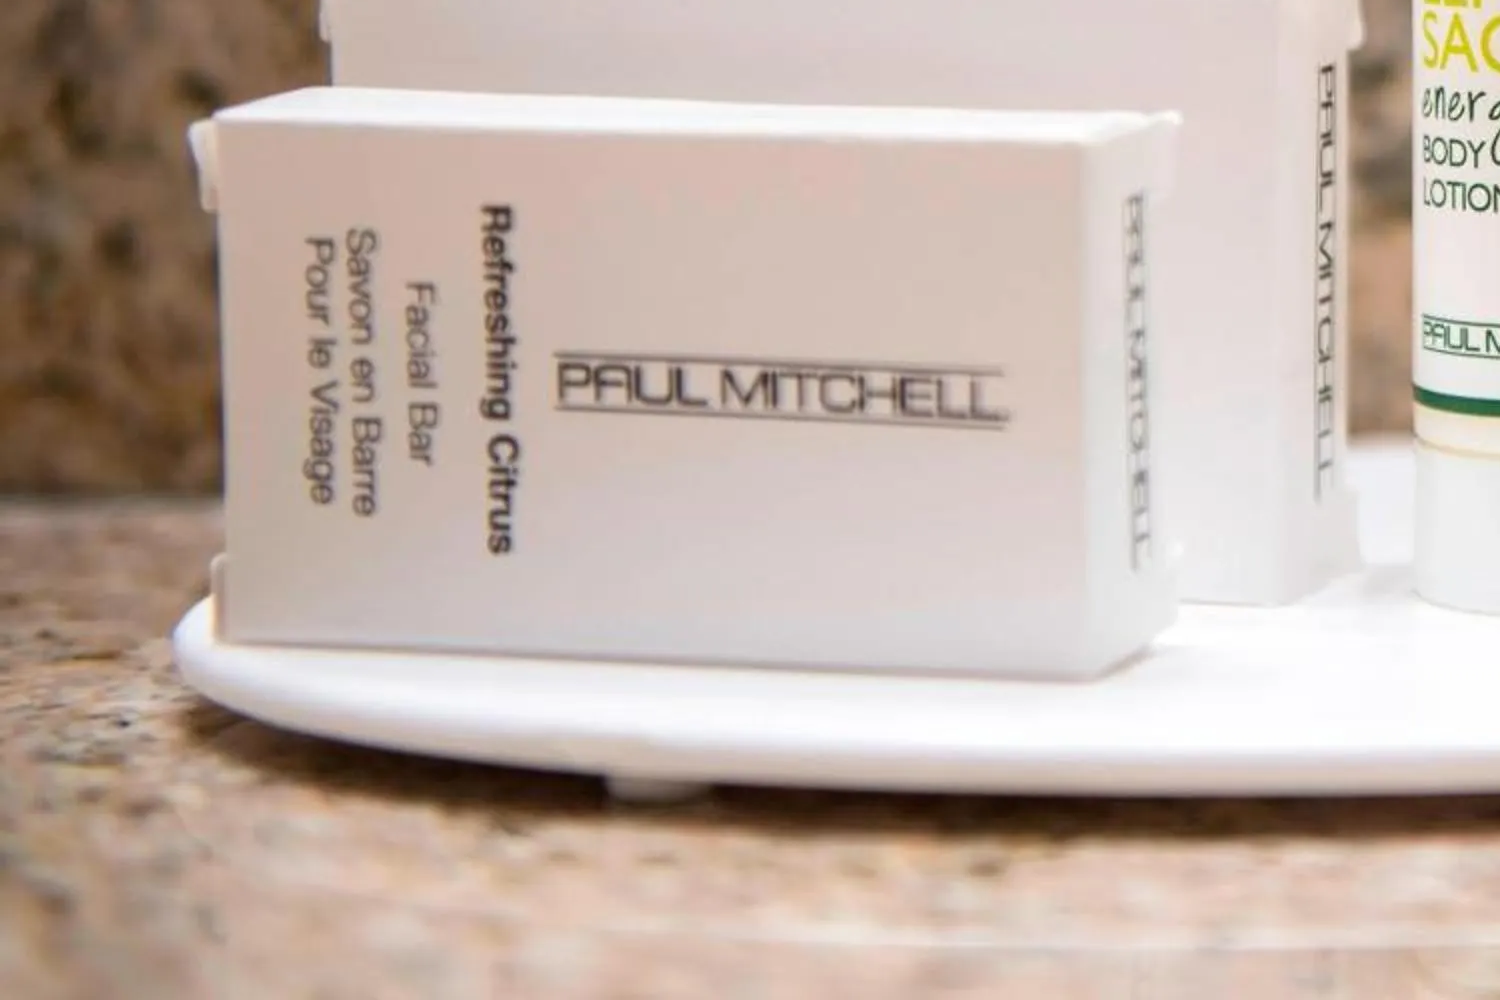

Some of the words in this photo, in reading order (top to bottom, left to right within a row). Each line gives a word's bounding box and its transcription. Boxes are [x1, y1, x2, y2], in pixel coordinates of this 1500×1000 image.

[1318, 64, 1336, 215] PAUL
[1423, 135, 1485, 167] BODY
[305, 238, 337, 324] Pour
[348, 228, 380, 344] Savon
[1125, 195, 1144, 319] PAUL
[309, 339, 338, 368] le
[406, 282, 438, 388] Facial
[480, 203, 518, 421] Refreshing
[1317, 221, 1335, 496] MITCHELL
[1423, 324, 1481, 353] PAUL
[351, 358, 377, 402] en
[556, 361, 709, 408] PAUL
[718, 367, 1006, 423] MITCHELL
[302, 380, 338, 504] Visage
[352, 417, 383, 516] Barre
[409, 402, 440, 466] Bar
[487, 434, 521, 554] Citrus
